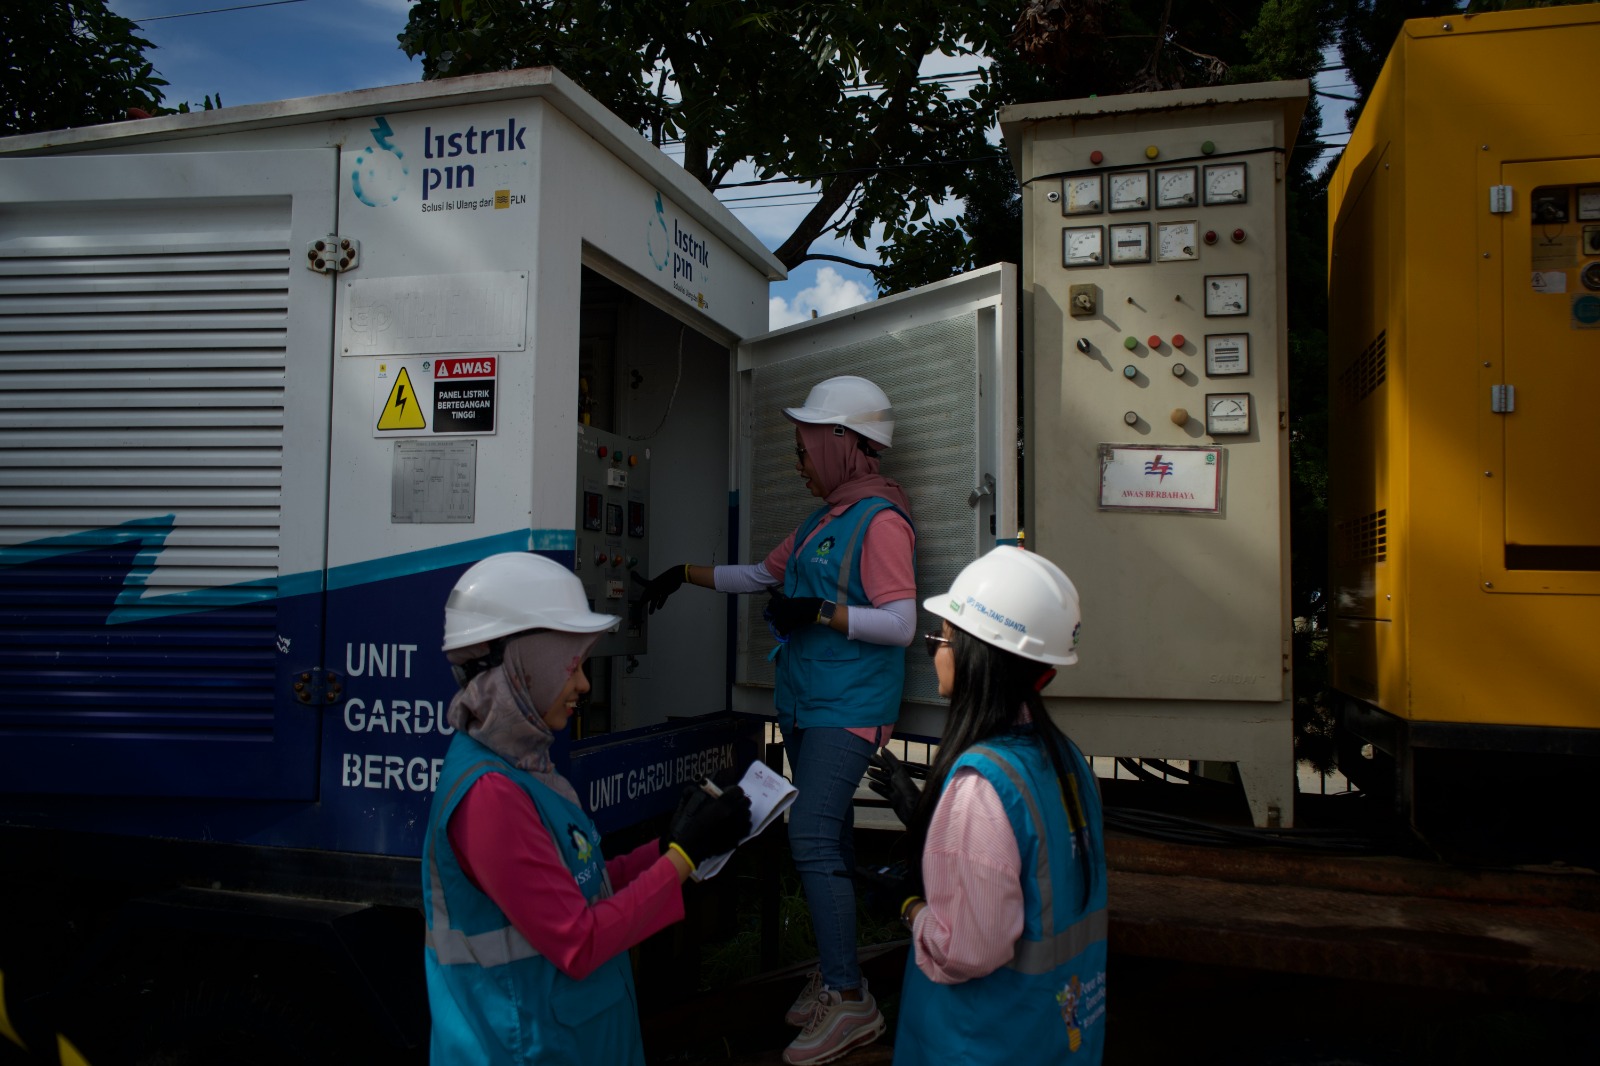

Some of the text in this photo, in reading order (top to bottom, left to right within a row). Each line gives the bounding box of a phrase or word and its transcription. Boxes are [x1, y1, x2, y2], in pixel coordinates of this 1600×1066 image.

[424, 118, 527, 159] listrik
[422, 164, 475, 200] pin
[421, 194, 526, 213] Solusi Isi Ulang dari PLN
[674, 219, 708, 268] listrik
[674, 252, 692, 281] pin
[452, 361, 491, 374] AWAS
[437, 400, 490, 410] BERTEGANGAN
[439, 390, 490, 399] PANEL LISTRIK
[451, 411, 476, 419] TINGGI
[1121, 490, 1194, 499] AWAS BERBAHAYA
[1004, 618, 1027, 634] SIANTA
[346, 642, 418, 678] UNIT
[344, 698, 455, 735] GARDU
[589, 772, 624, 812] UNIT
[627, 760, 673, 800] GARDU
[676, 742, 734, 785] BERGERAK
